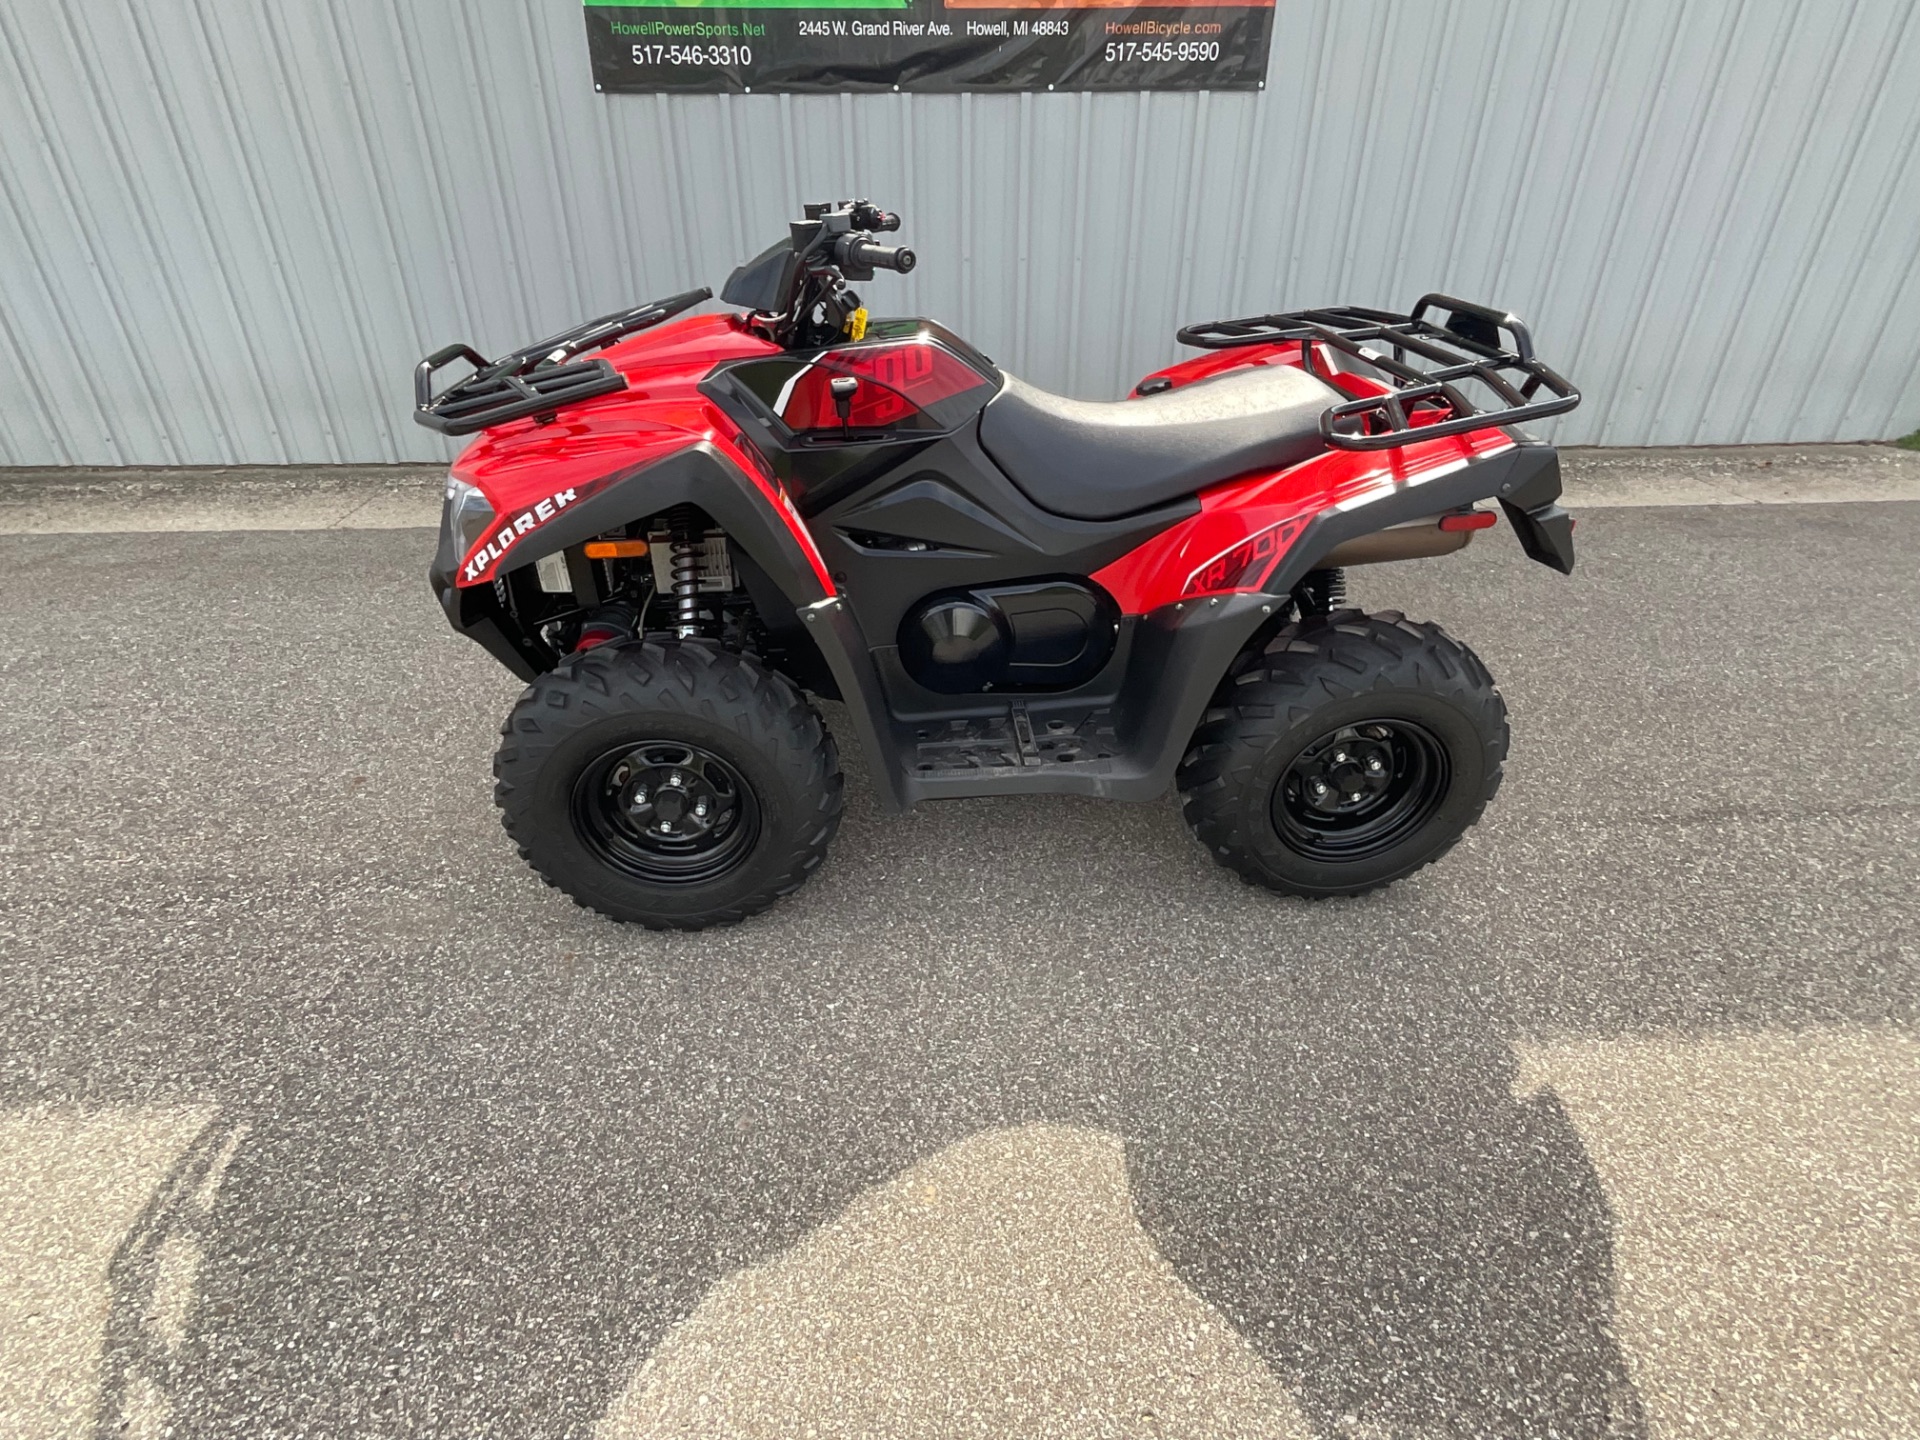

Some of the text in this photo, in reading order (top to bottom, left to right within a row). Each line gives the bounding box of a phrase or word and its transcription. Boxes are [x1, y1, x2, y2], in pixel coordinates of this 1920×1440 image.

[610, 21, 766, 38] HowellPowerSports.Net
[798, 20, 1070, 38] 2445 W. Grand River Ave. Howell, MI 48843
[1104, 21, 1222, 38] HowellBicycle.com
[631, 44, 751, 66] 517-546-3310
[1104, 41, 1220, 62] 517-545-9590
